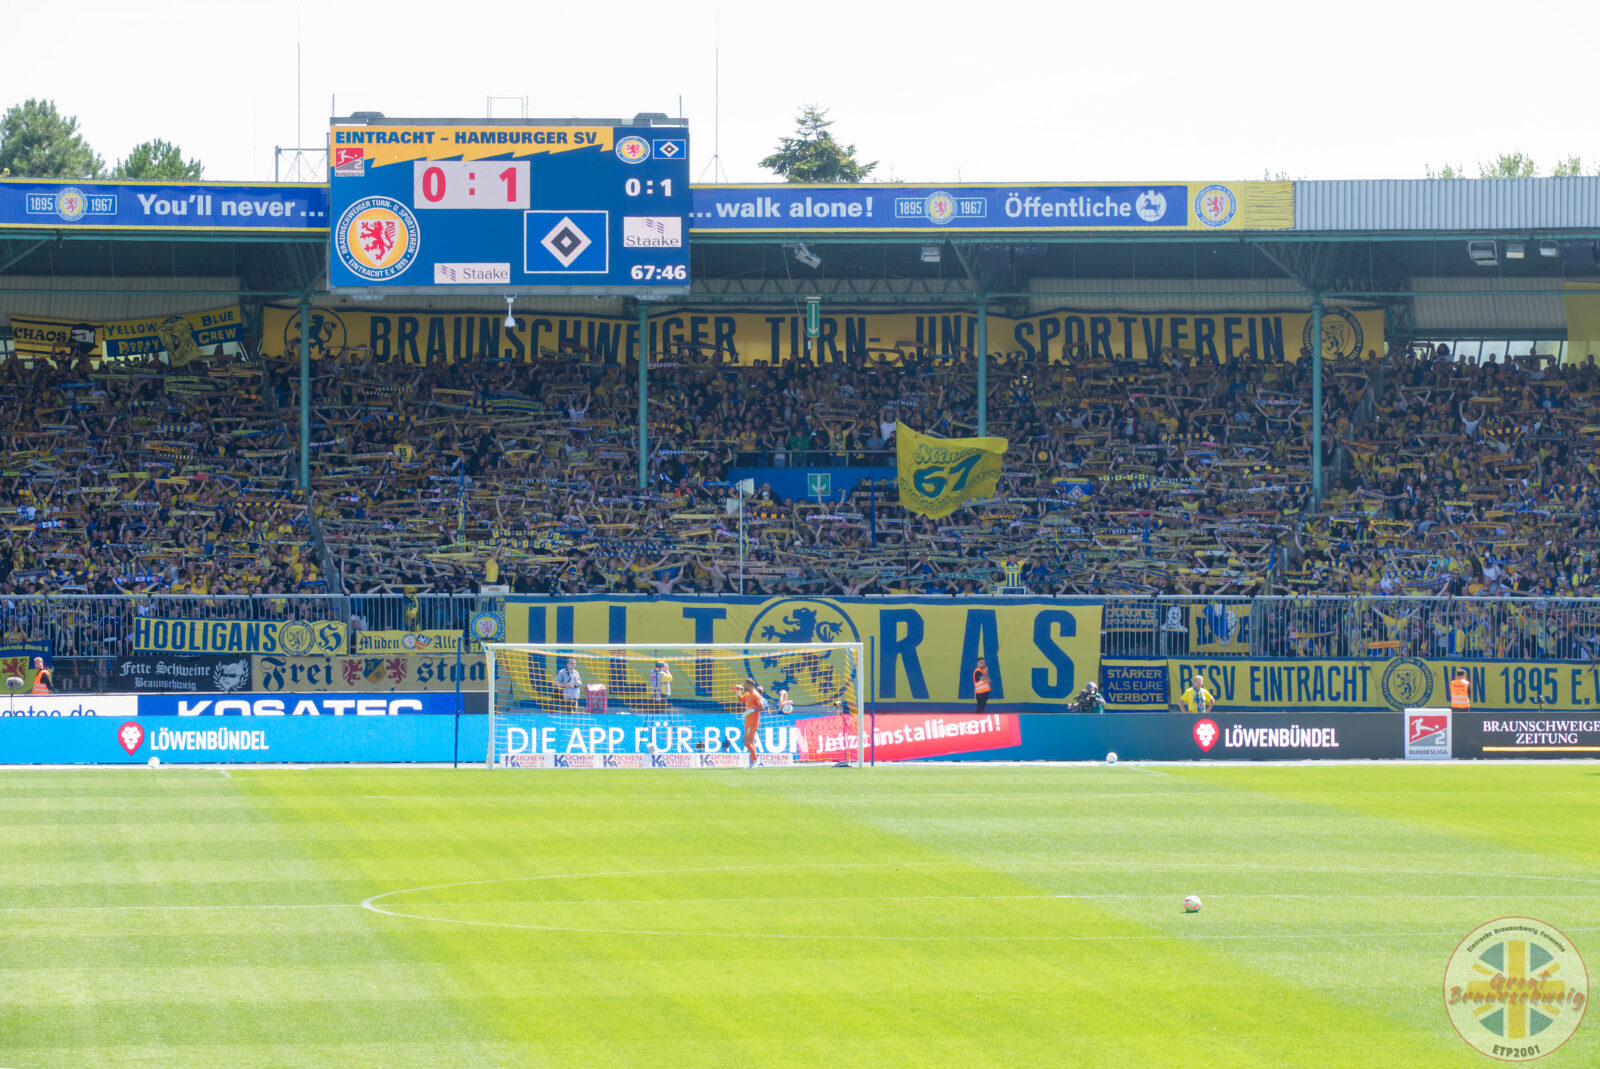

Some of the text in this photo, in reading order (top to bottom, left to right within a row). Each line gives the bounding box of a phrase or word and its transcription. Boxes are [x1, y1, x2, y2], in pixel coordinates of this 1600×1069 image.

[335, 131, 435, 144] EINTRACHT
[455, 131, 567, 145] HAMBURGER
[575, 131, 597, 144] SV
[422, 167, 446, 203] 0
[499, 167, 517, 202] 1
[30, 197, 53, 211] 1895
[91, 199, 112, 212] 1967
[789, 197, 873, 218] alone!
[899, 201, 922, 214] 1895
[960, 201, 982, 215] 1967
[1005, 192, 1131, 217] Öffentliche
[626, 235, 679, 248] Staake
[463, 267, 508, 280] Staake
[631, 265, 686, 279] 67:46
[202, 310, 235, 326] BLUE
[13, 327, 67, 342] CHAOS
[198, 327, 237, 344] CREW
[1014, 316, 1285, 368] SPORTVEREIN
[135, 619, 277, 652] HOOLIGANS
[434, 636, 457, 649] Alle
[120, 661, 211, 677] Fette Schweine
[417, 657, 488, 683] Staa
[1107, 667, 1162, 679] STÄRKER
[135, 677, 196, 691] Braunschweig
[1108, 680, 1163, 690] ALS EURE
[1250, 666, 1371, 702] EINTRACHT
[1500, 667, 1558, 704] 1895
[1109, 693, 1164, 702] VERBOTE
[1483, 721, 1600, 732] BRAUNSCHWEIGE
[150, 729, 269, 750] LÖWENBÜNDEL
[507, 728, 556, 753] DIE
[566, 728, 624, 753] APP
[635, 722, 693, 753] FÜR
[1225, 726, 1339, 748] LÖWENBÜNDEL
[1435, 730, 1445, 745] 2
[1516, 733, 1578, 744] ZEITUNG
